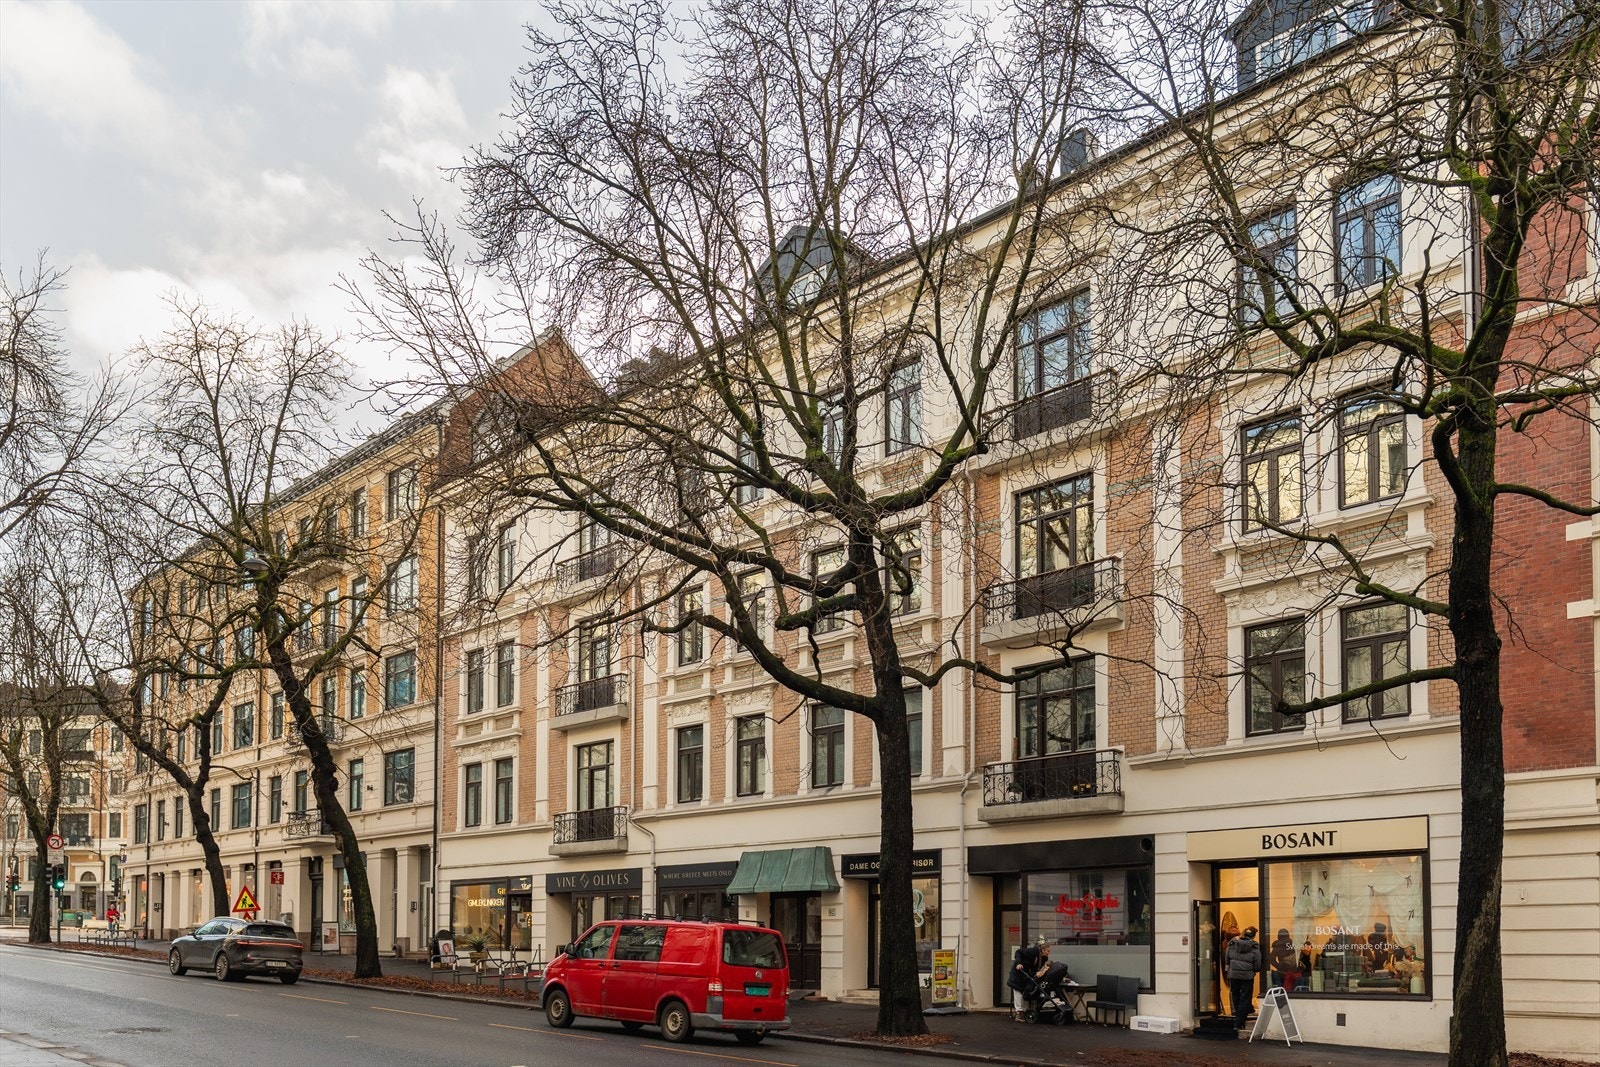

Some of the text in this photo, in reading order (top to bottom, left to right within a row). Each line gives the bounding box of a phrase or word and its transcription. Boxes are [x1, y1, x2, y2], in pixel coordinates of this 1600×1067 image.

[1262, 830, 1338, 850] BOSANT
[849, 862, 869, 870] DAME
[870, 861, 880, 869] OG
[681, 871, 701, 879] GREECE
[718, 869, 732, 877] OSLO
[556, 872, 630, 888] VINE OLIVES
[1315, 925, 1361, 936] BOSANT
[1310, 942, 1337, 950] dreams
[1374, 942, 1384, 950] of
